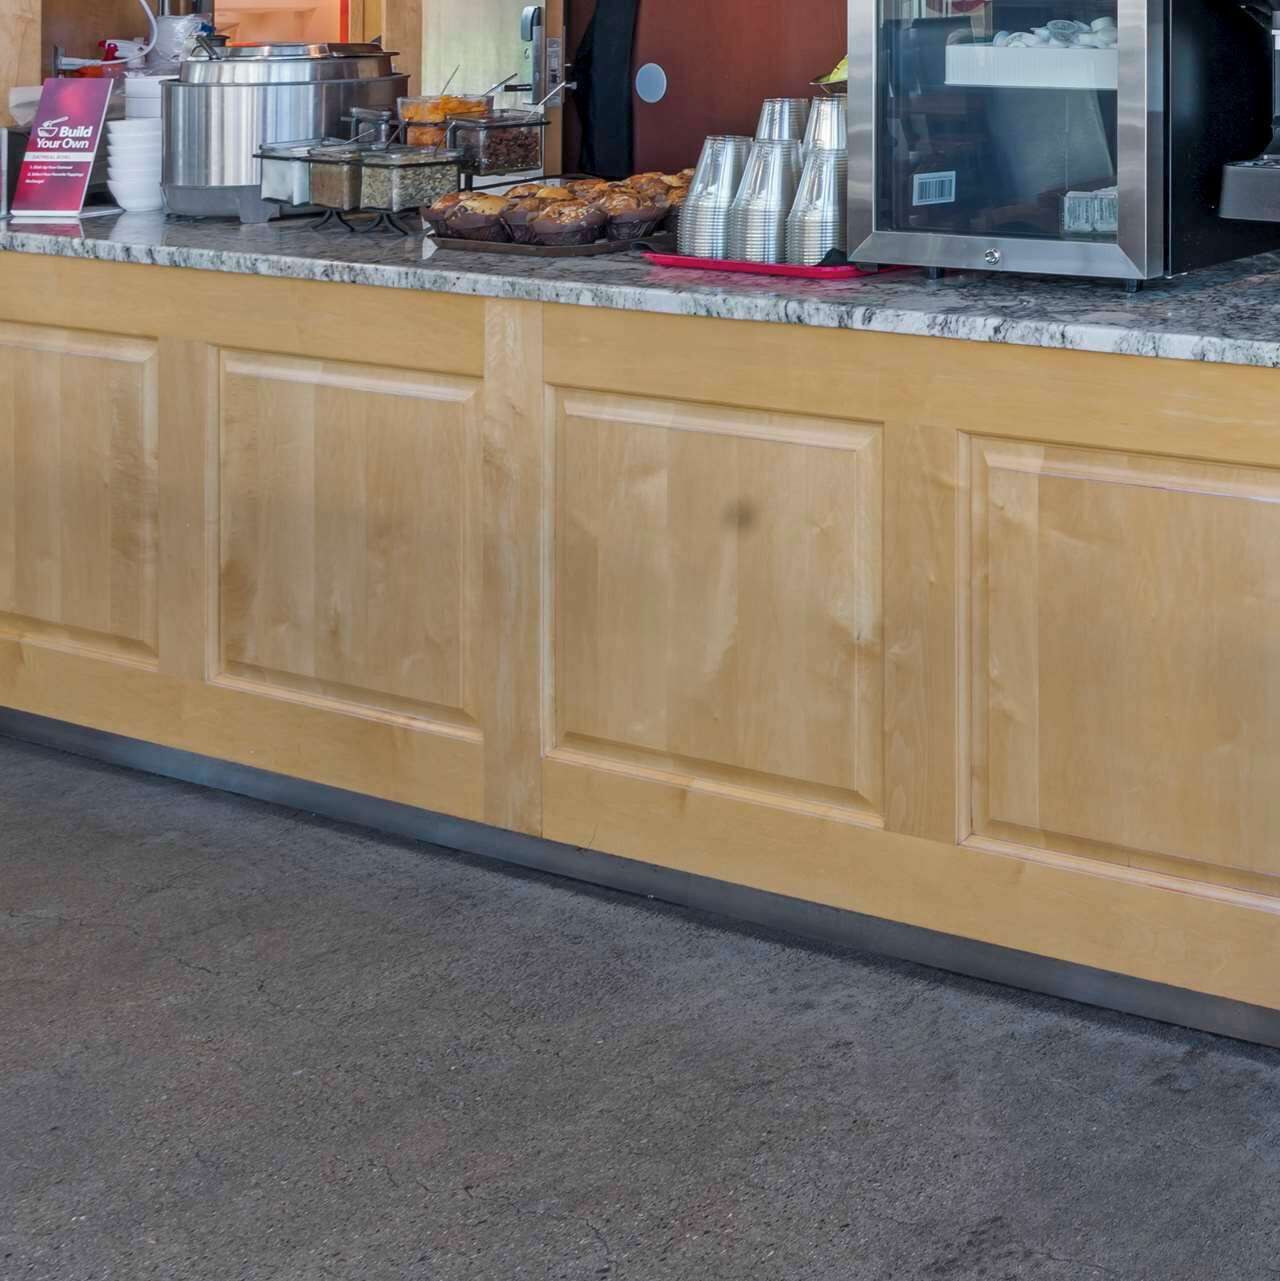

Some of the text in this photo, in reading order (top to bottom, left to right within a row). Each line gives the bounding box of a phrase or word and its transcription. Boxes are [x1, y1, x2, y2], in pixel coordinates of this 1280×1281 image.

[59, 126, 93, 137] Build
[37, 138, 89, 148] Your Own
